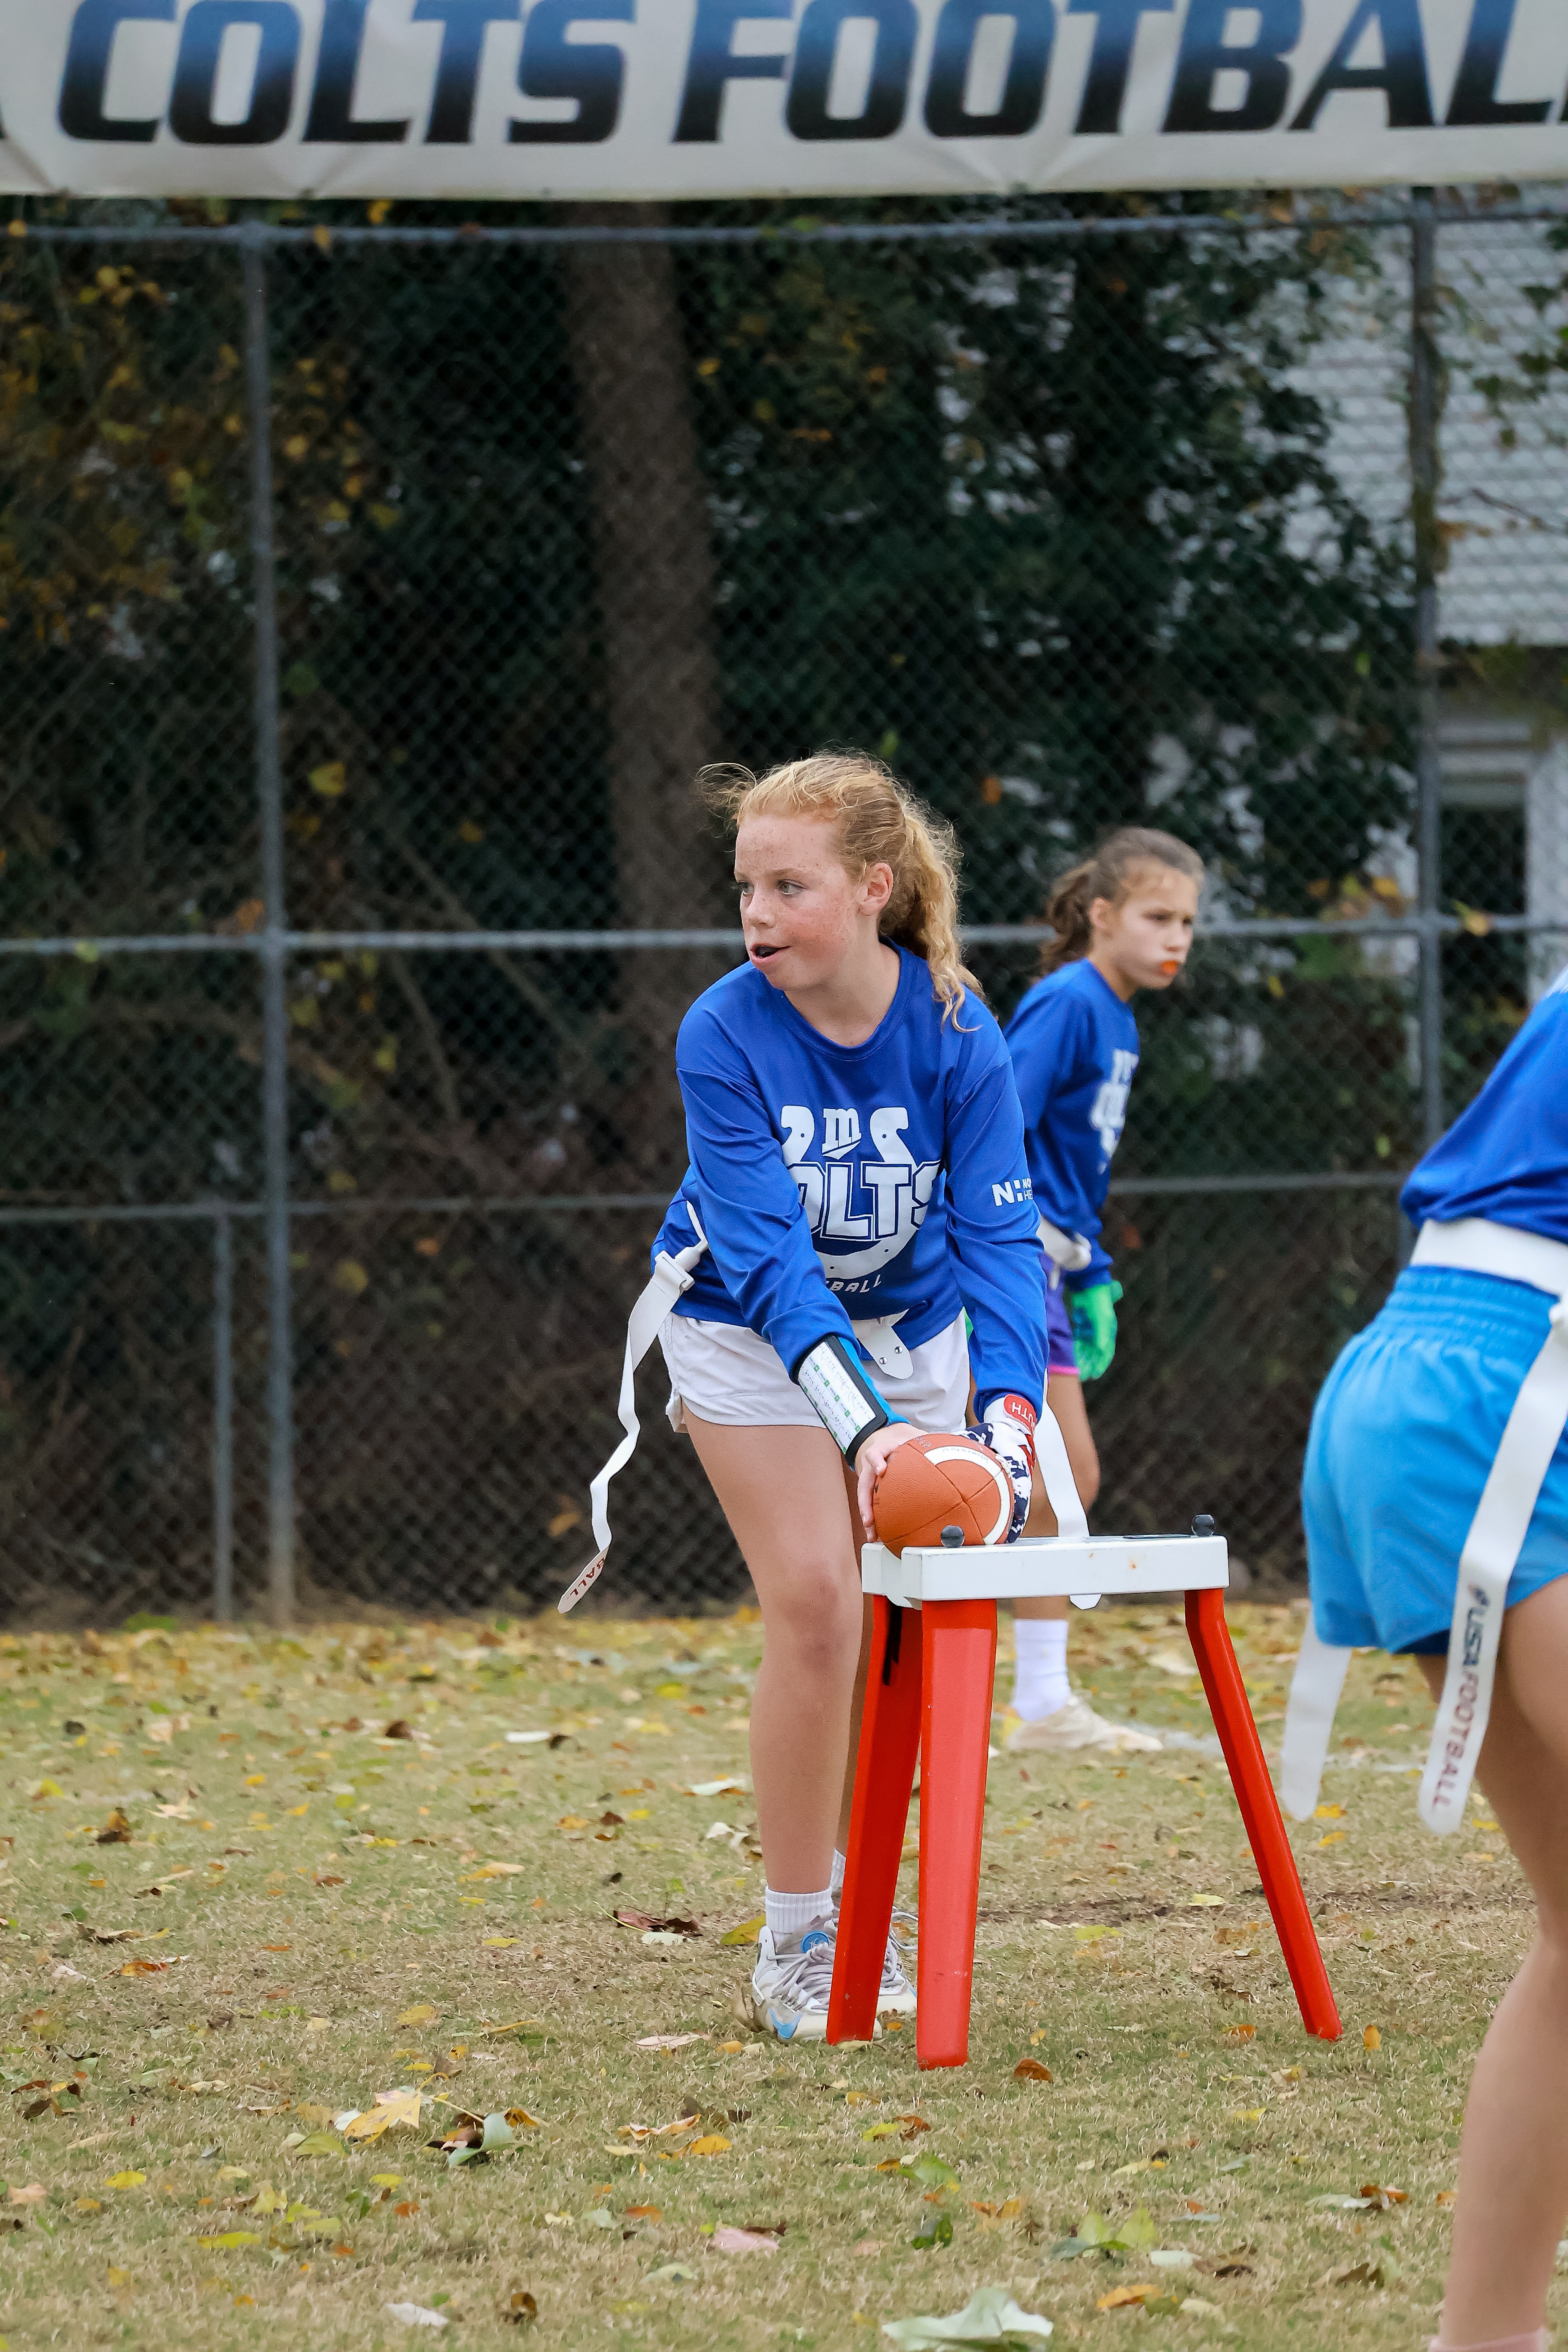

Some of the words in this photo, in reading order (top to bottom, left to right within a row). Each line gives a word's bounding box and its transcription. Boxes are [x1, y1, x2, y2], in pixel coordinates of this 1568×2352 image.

[58, 0, 637, 145] COLTS
[670, 0, 1568, 144] FOOTBAL
[786, 1160, 940, 1241] OLTS
[1432, 1668, 1480, 1808] FOOTBALL
